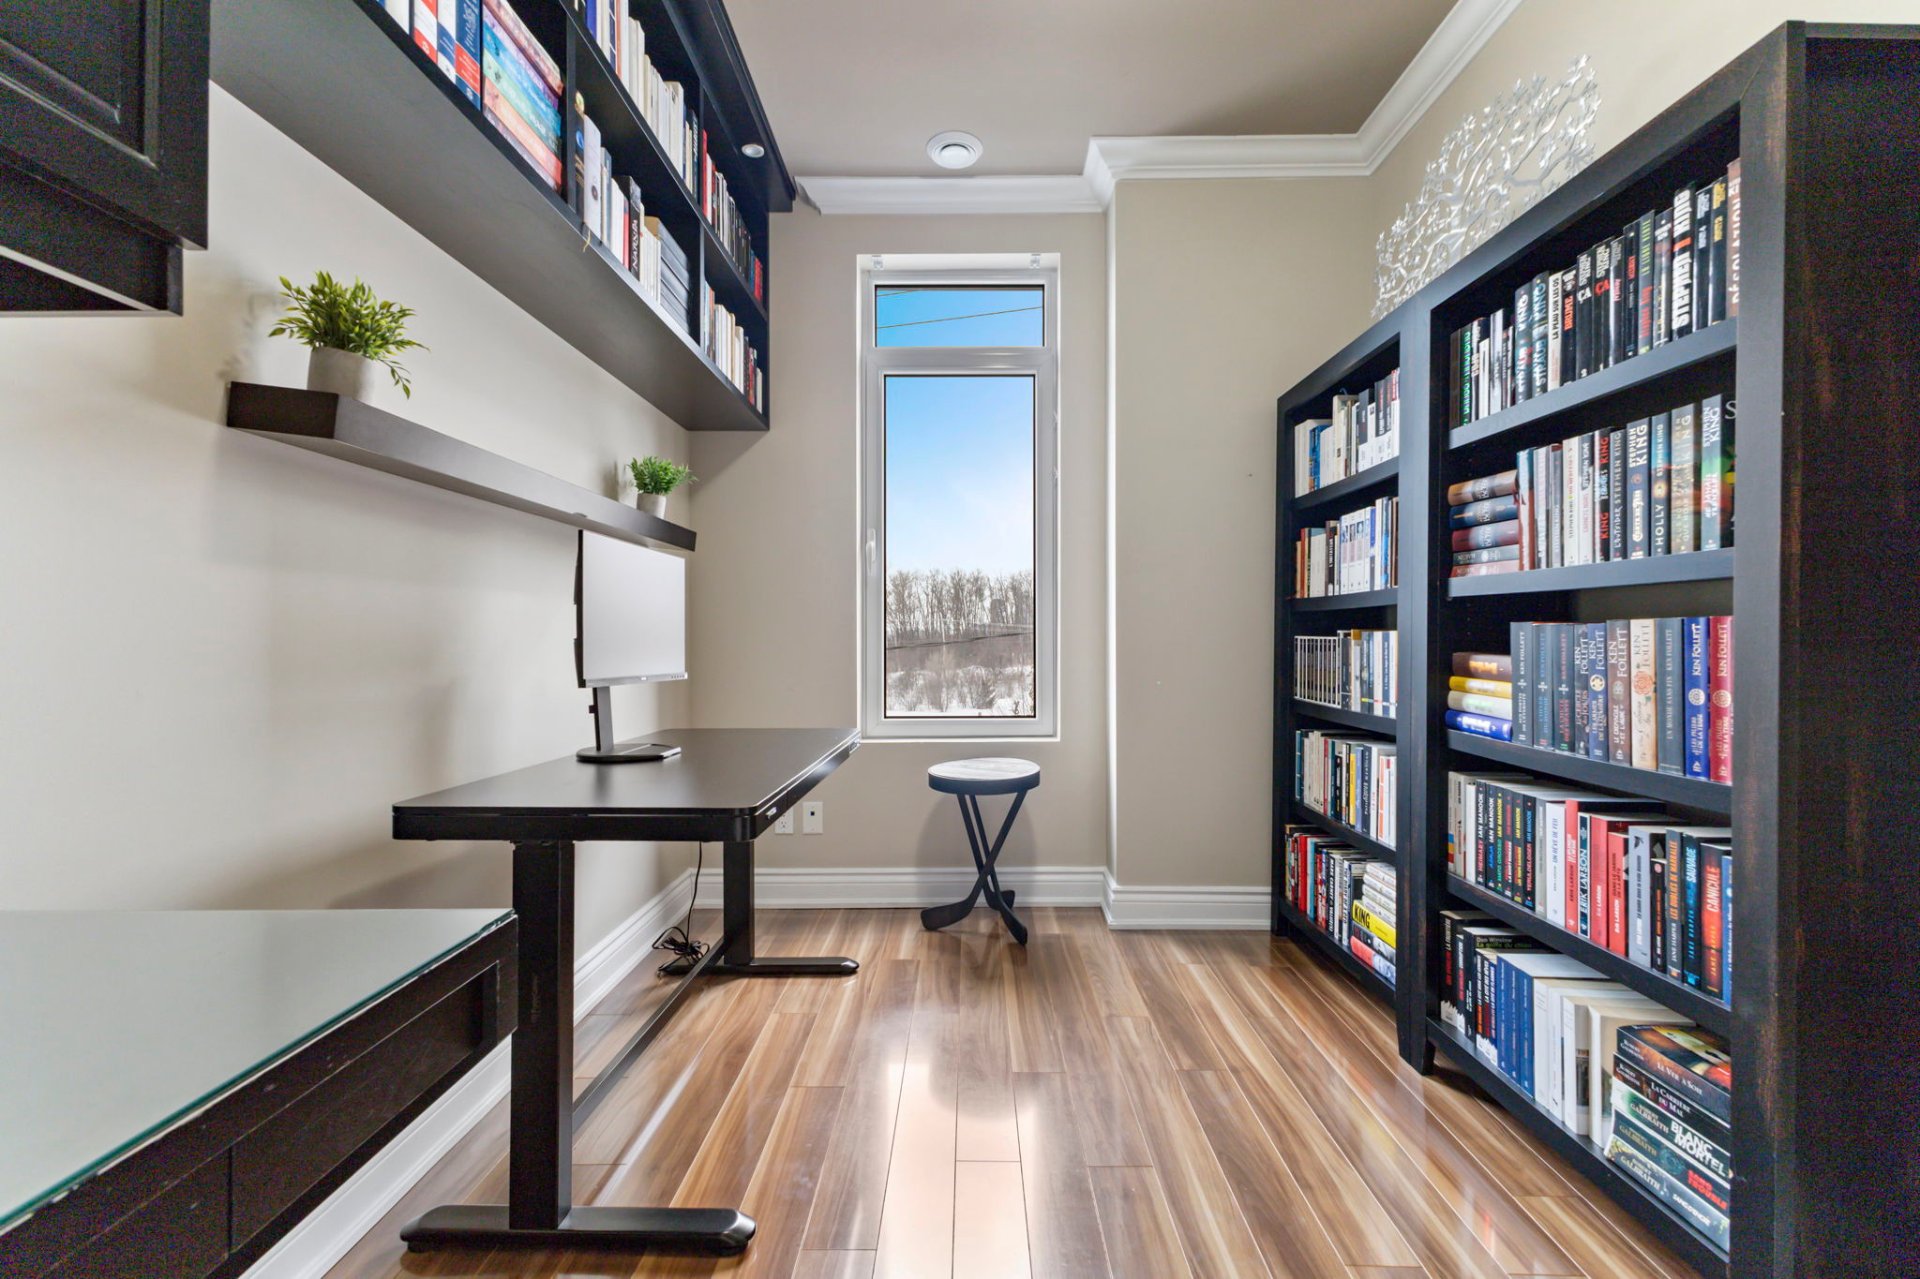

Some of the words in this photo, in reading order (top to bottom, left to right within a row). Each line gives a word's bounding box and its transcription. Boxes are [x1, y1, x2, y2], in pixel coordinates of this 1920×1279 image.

[1672, 189, 1692, 238] KING
[1672, 250, 1692, 330] STEPHEN
[1563, 296, 1573, 331] BRUME
[1656, 423, 1664, 442] KING
[1702, 407, 1712, 448] STEPHEN
[1709, 407, 1720, 443] KING
[1600, 437, 1609, 464] KING
[1612, 431, 1622, 458] KING
[1628, 427, 1637, 468] STEPHEN
[1635, 424, 1647, 465] KING
[1655, 443, 1664, 477] STEPHEN
[1613, 460, 1622, 504] STEPHEN
[1600, 512, 1609, 539] KING
[1656, 504, 1665, 545] HOLLY
[1580, 638, 1589, 674] FOLLETT
[1589, 640, 1597, 659] KEN
[1595, 629, 1605, 670] FOLLETT
[1609, 642, 1618, 664] KEN
[1616, 628, 1628, 677] FOLLETT
[1691, 623, 1702, 658] FOLLETT
[1716, 623, 1728, 658] FOLLETT
[1692, 659, 1702, 676] KEN
[1717, 659, 1728, 676] KEN
[1579, 848, 1588, 889] LARSON
[1686, 847, 1697, 884] SAUVAGE
[1579, 890, 1588, 914] ERIK
[1706, 865, 1720, 913] CANICULE
[1353, 902, 1370, 929] KING
[1709, 956, 1717, 976] JANE
[1671, 1120, 1713, 1151] BLANC
[1620, 1155, 1661, 1190] GALBRAITH
[1674, 1132, 1726, 1178] MORTEL
